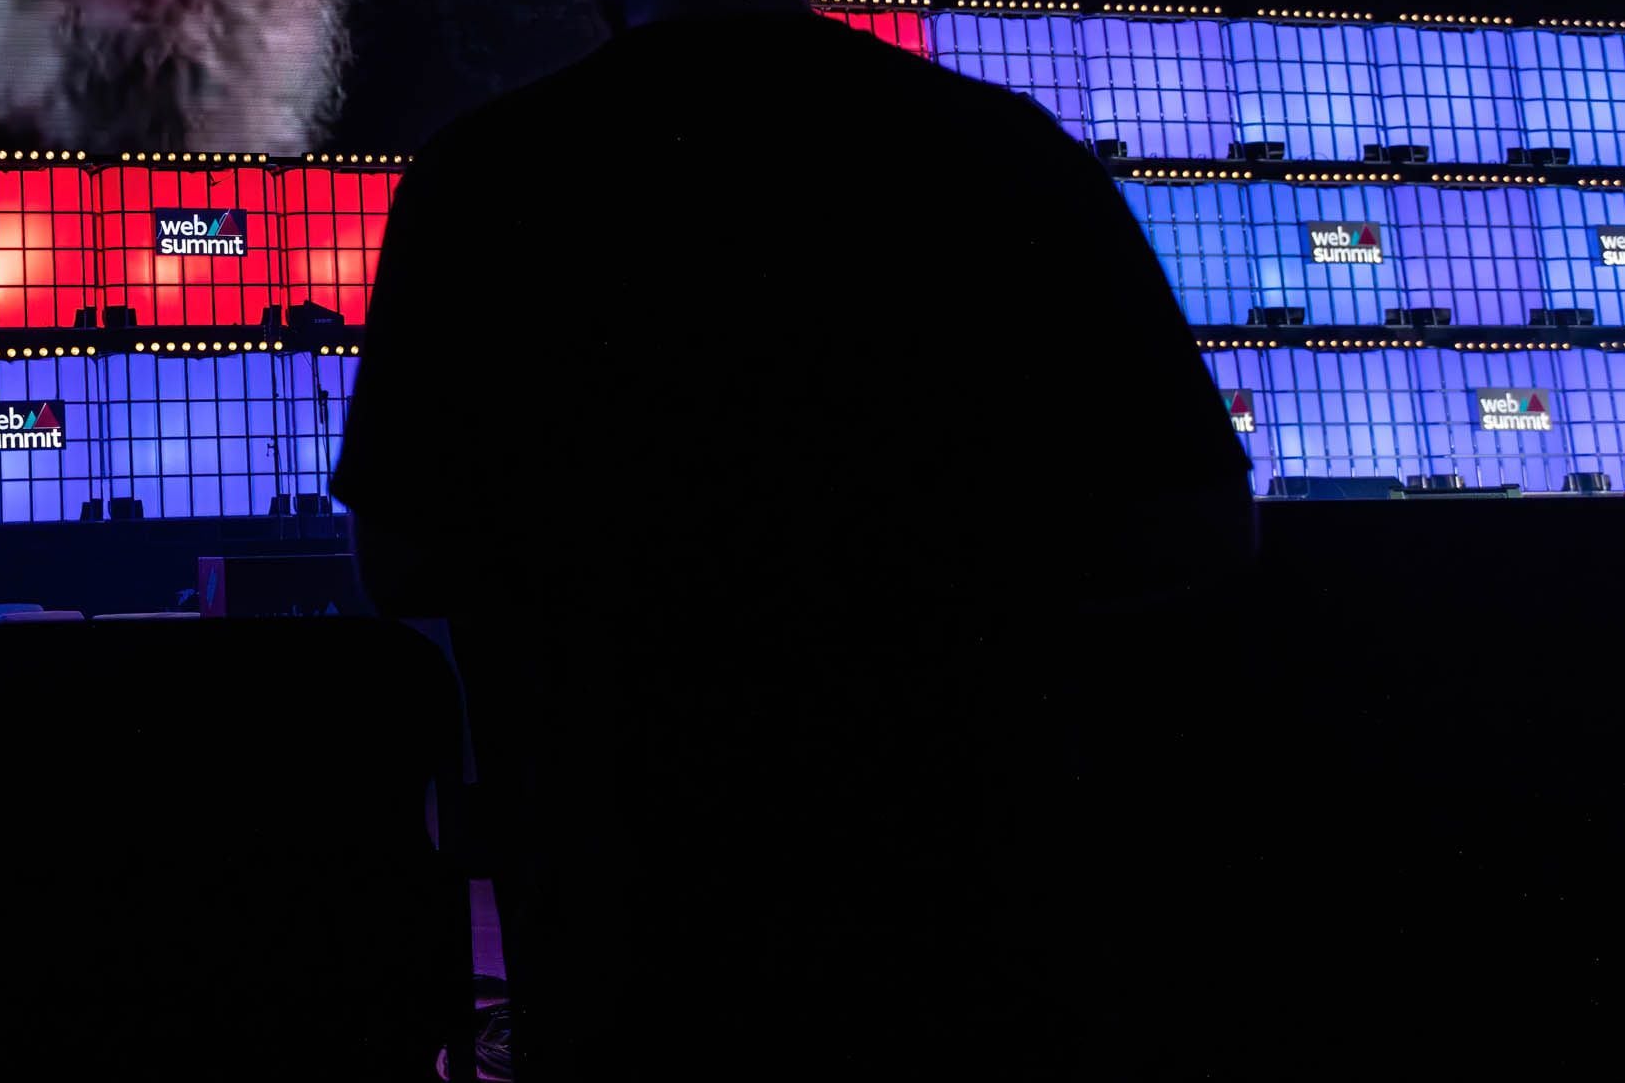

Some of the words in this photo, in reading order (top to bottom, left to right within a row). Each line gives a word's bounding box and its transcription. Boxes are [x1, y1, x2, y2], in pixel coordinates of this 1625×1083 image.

[160, 214, 208, 236] web
[1311, 226, 1350, 246] web
[161, 237, 244, 255] summit
[1313, 247, 1382, 263] summit
[1480, 393, 1518, 413] web
[1483, 412, 1550, 430] summit
